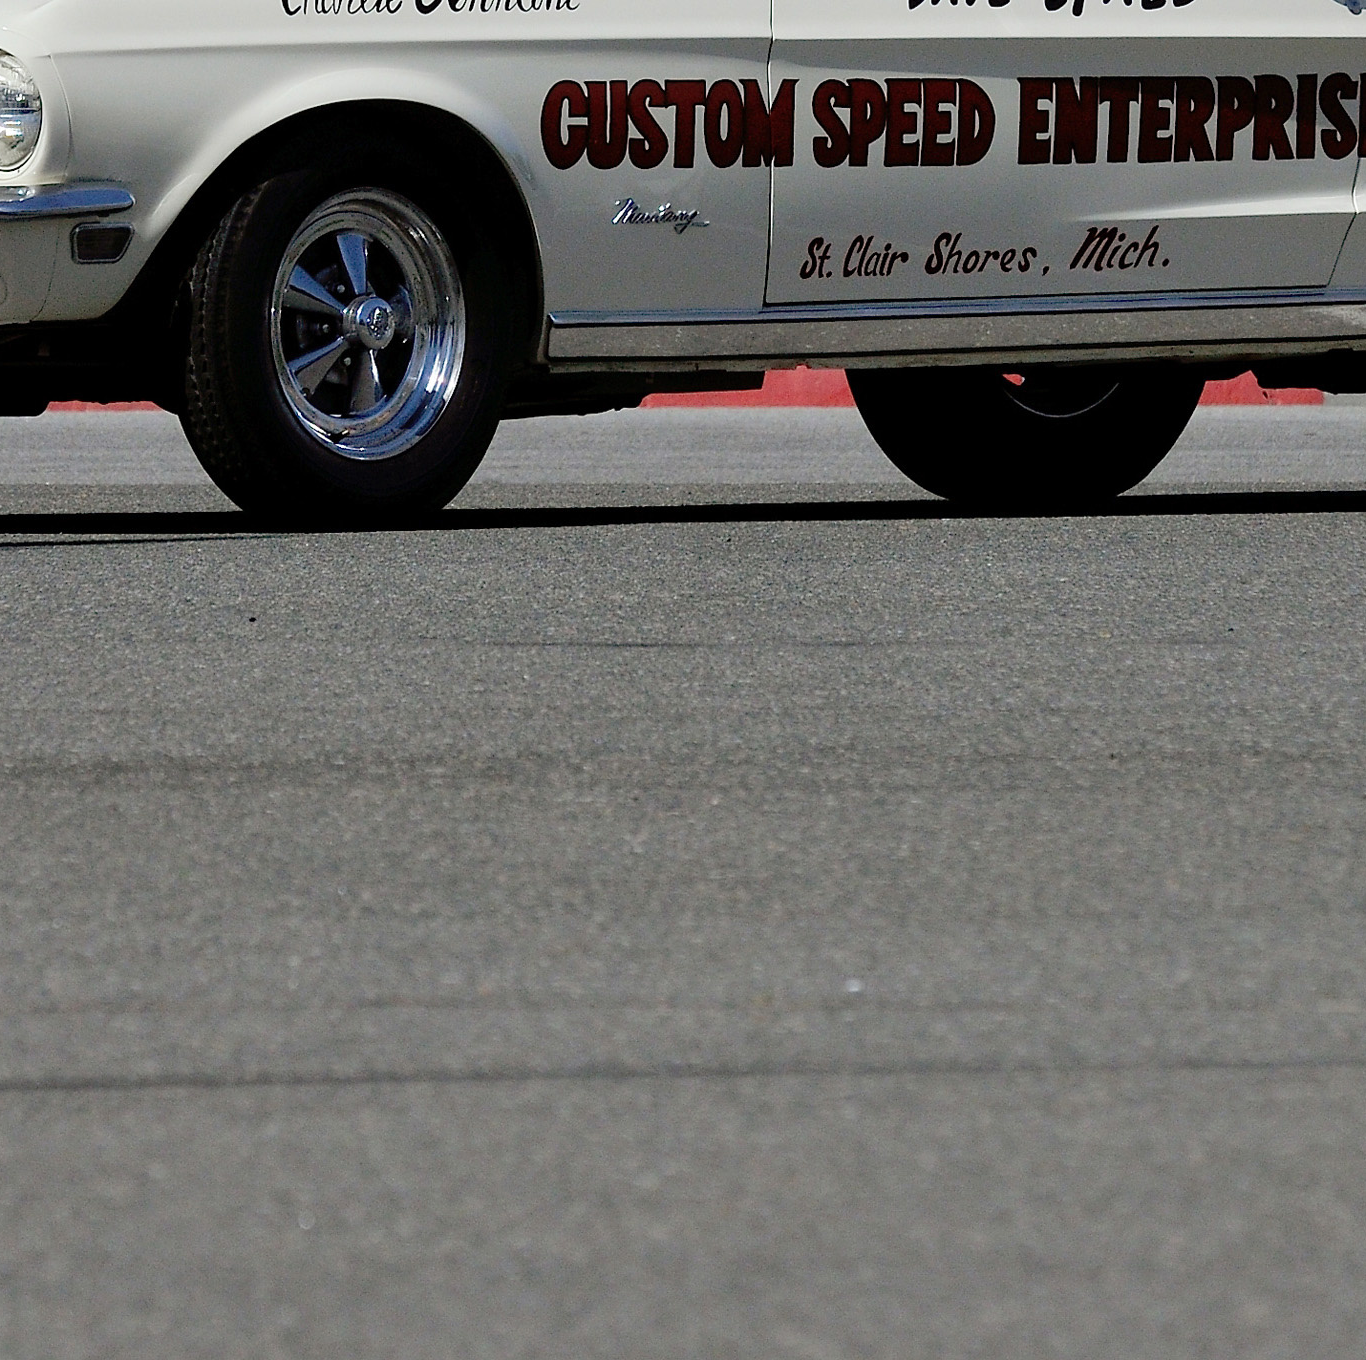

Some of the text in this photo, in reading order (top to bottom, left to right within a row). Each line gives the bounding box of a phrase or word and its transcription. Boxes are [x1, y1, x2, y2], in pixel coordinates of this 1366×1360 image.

[540, 78, 799, 169] CUSTOM
[811, 77, 996, 169] SPEED
[799, 237, 833, 280] St.
[842, 234, 910, 278] Clair
[1069, 224, 1170, 272] Mich.
